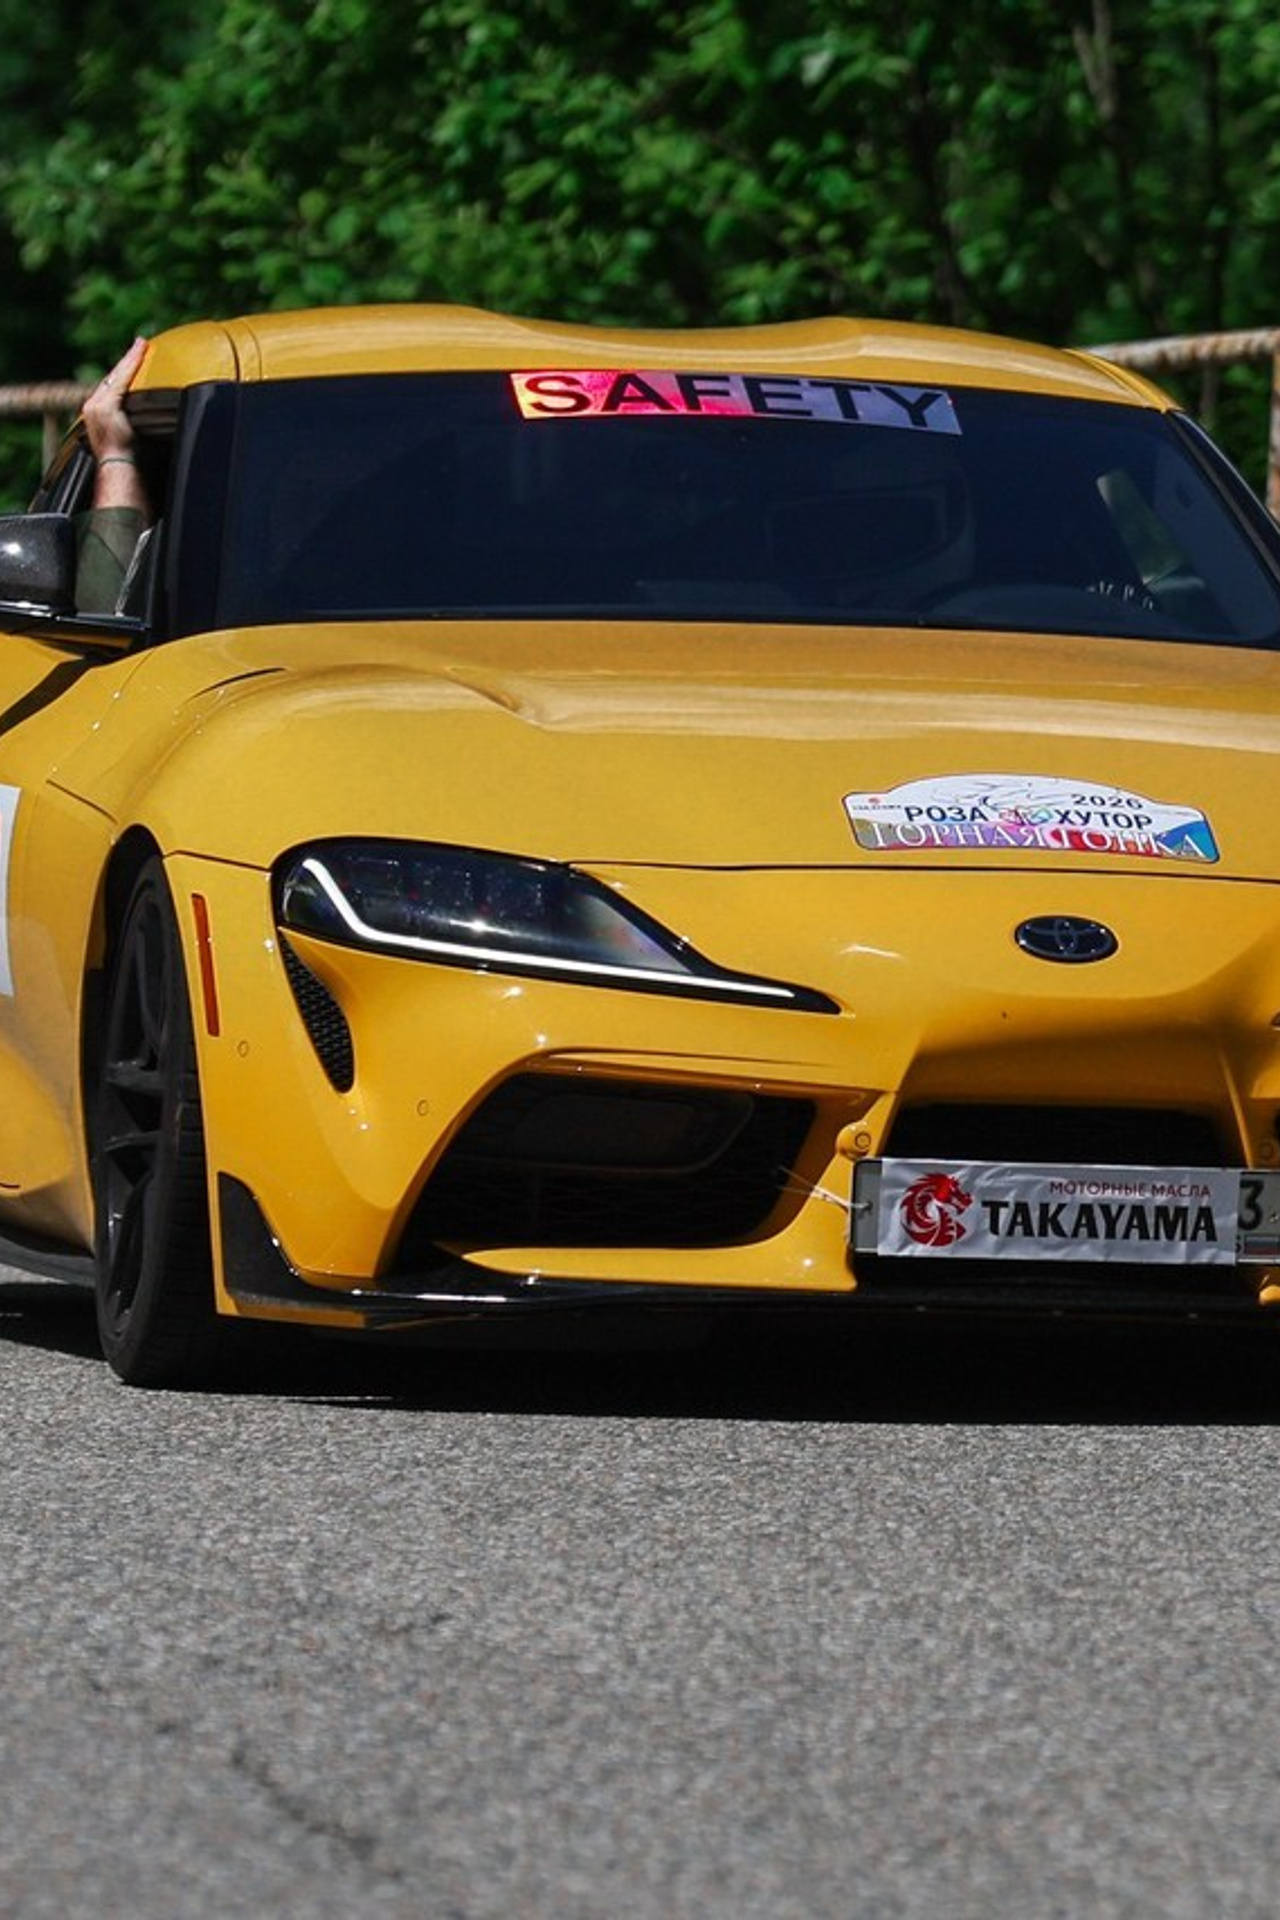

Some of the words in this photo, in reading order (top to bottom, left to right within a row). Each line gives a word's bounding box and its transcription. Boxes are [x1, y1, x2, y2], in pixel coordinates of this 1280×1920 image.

[523, 373, 943, 428] SAFETY
[1071, 793, 1144, 810] 2026
[904, 805, 989, 823] РОЗА
[1055, 809, 1153, 830] ХУТОР
[871, 822, 1047, 847] ГОРНАЯ
[1050, 1181, 1147, 1198] МОТОРНЫЕ
[1151, 1184, 1211, 1198] МАСЛА
[981, 1199, 1218, 1242] TAKAYAMA
